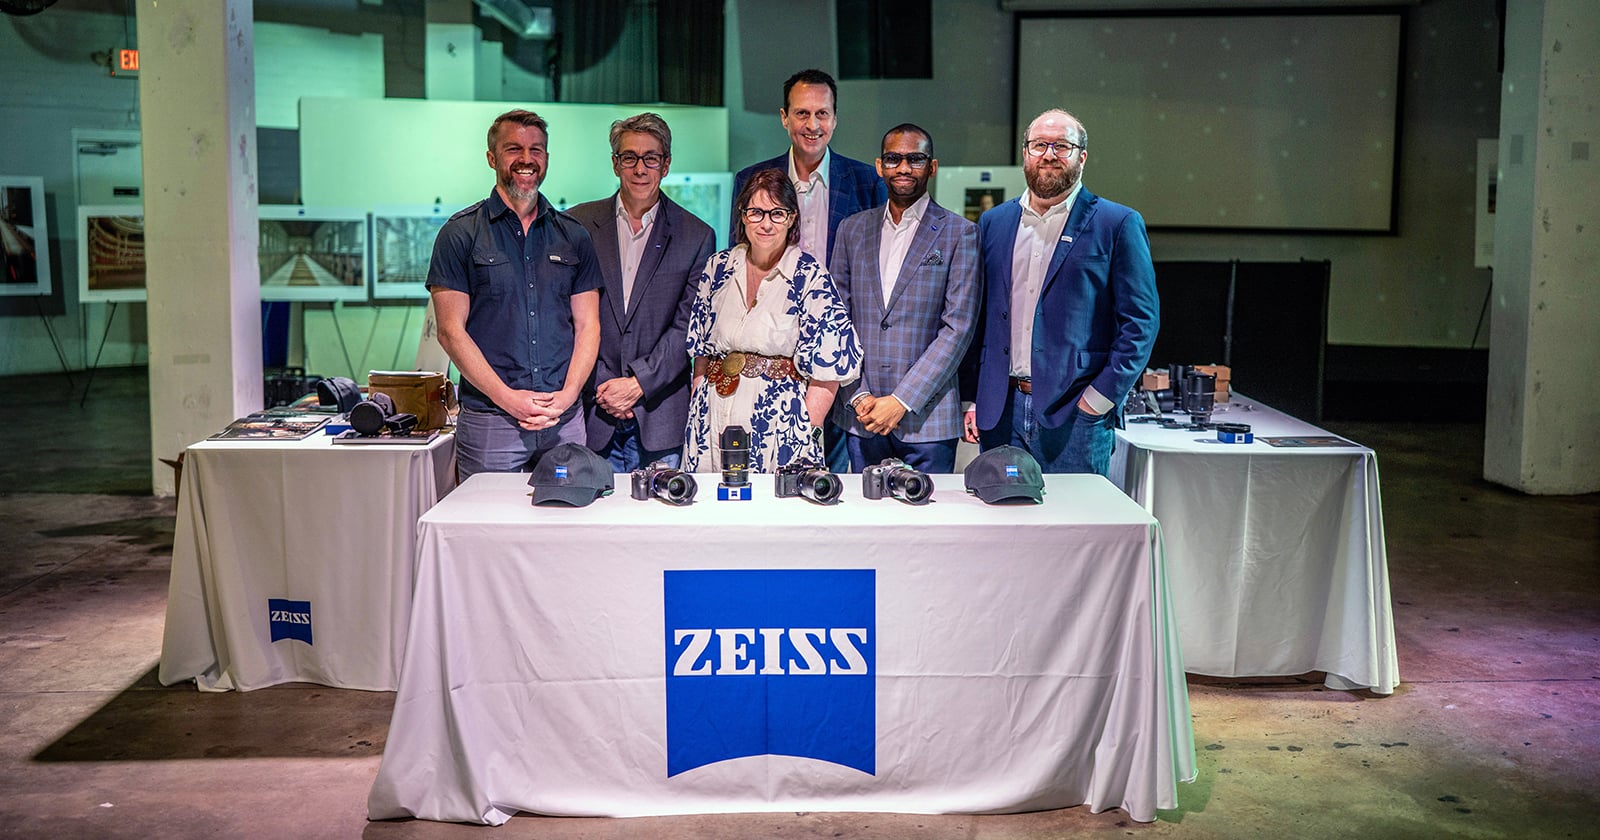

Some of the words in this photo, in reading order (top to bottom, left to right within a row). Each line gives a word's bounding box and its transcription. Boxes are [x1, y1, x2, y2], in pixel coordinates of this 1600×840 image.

[120, 49, 139, 70] EXI
[271, 610, 310, 625] ZEISS
[673, 628, 868, 677] ZEISS
